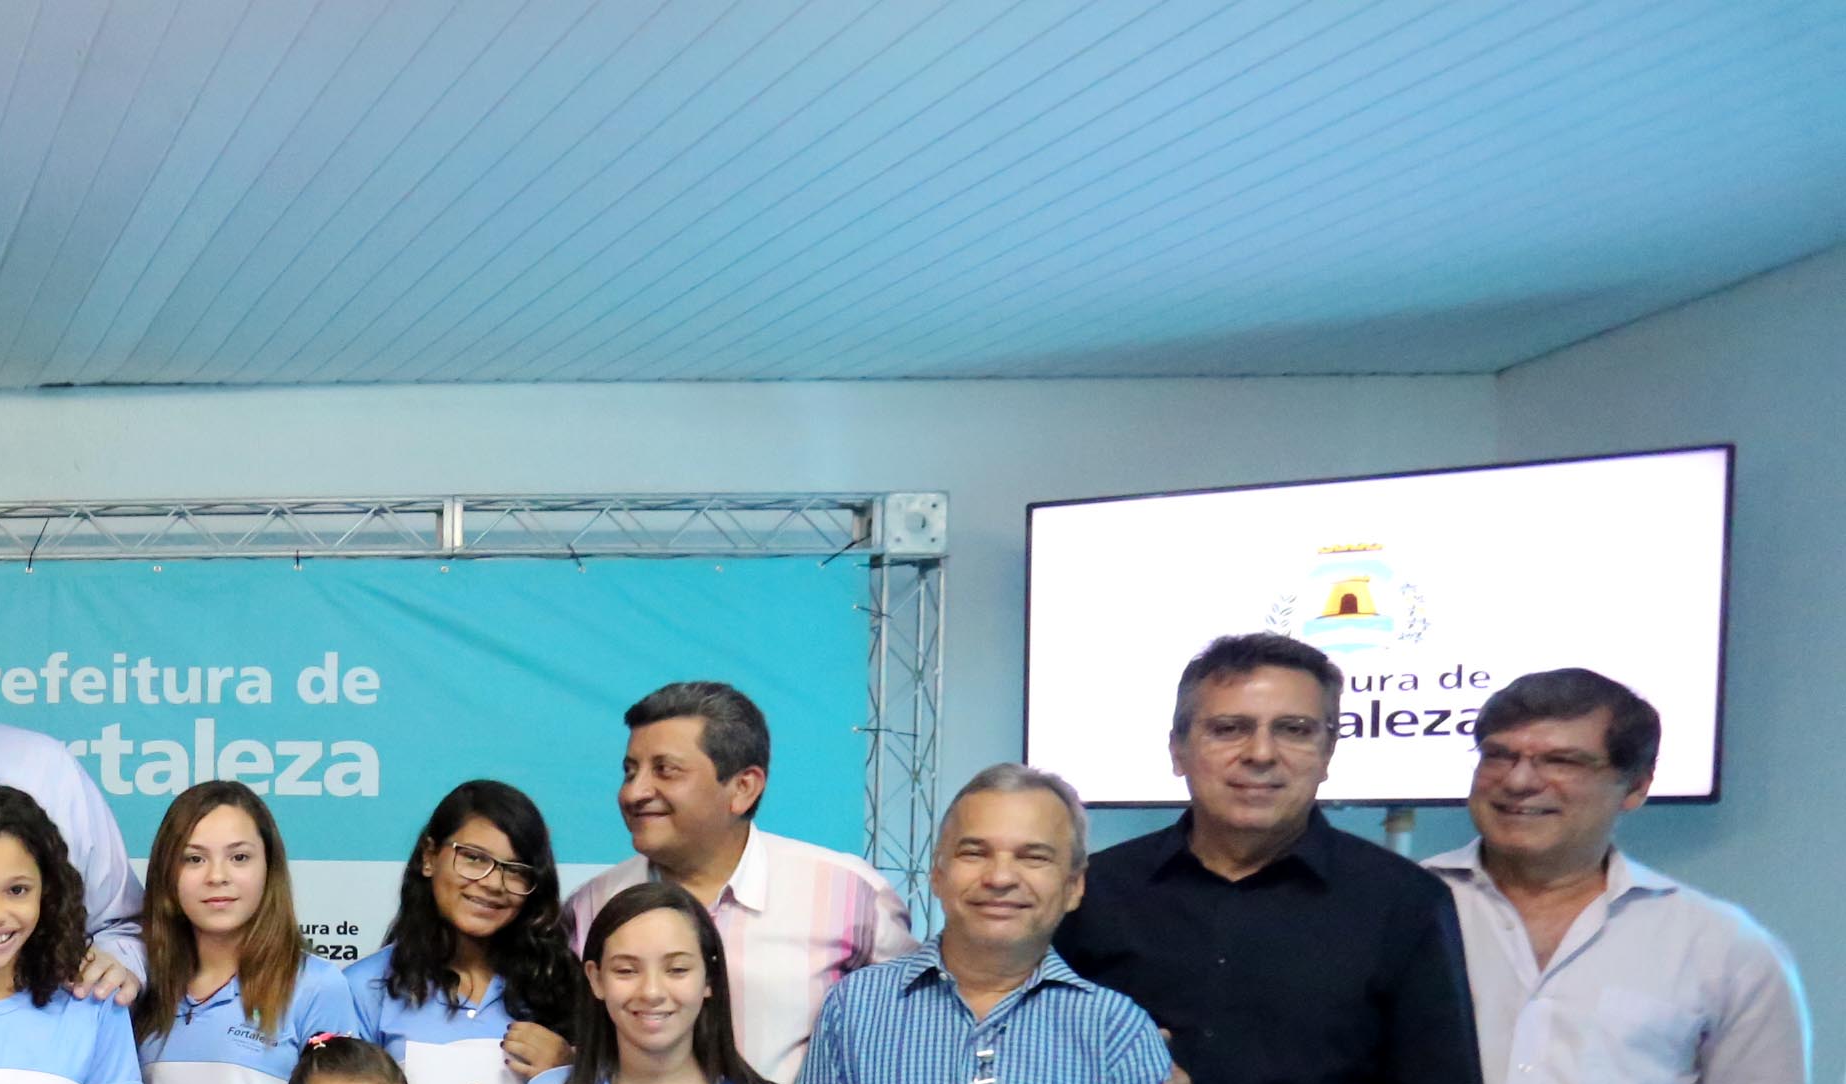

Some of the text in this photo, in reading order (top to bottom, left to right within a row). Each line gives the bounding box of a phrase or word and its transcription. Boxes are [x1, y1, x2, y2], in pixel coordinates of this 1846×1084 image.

[297, 651, 380, 705] de
[1439, 664, 1491, 690] de
[1339, 700, 1482, 740] aleza
[66, 718, 380, 797] taleza
[336, 921, 359, 935] de
